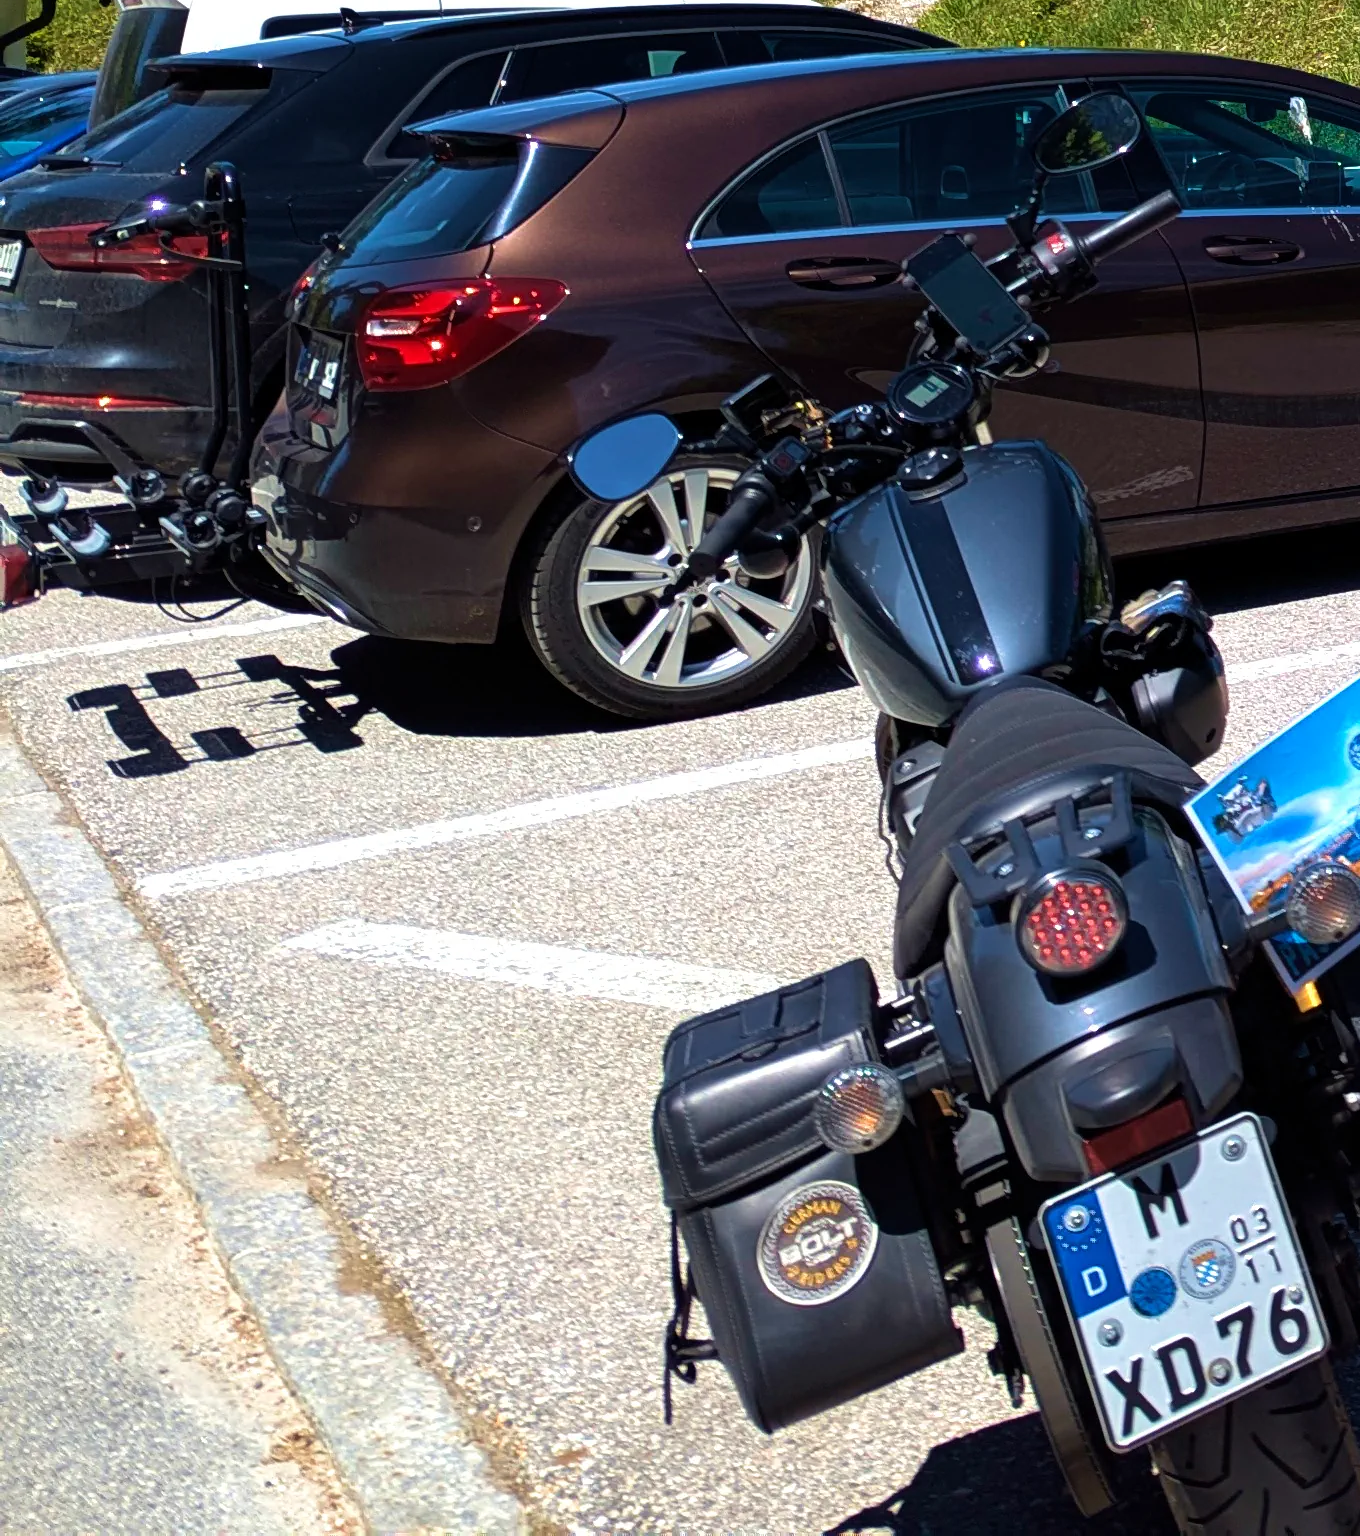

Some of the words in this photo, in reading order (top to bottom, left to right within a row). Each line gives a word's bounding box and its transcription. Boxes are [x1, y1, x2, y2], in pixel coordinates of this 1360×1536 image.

[783, 1199, 842, 1235] GERMAN
[1131, 1161, 1189, 1240] M
[778, 1216, 859, 1268] BOLT
[1229, 1205, 1272, 1245] 03
[1081, 1264, 1109, 1299] D
[1244, 1245, 1283, 1285] 11
[1104, 1333, 1208, 1438] XD
[1215, 1285, 1311, 1381] 76
